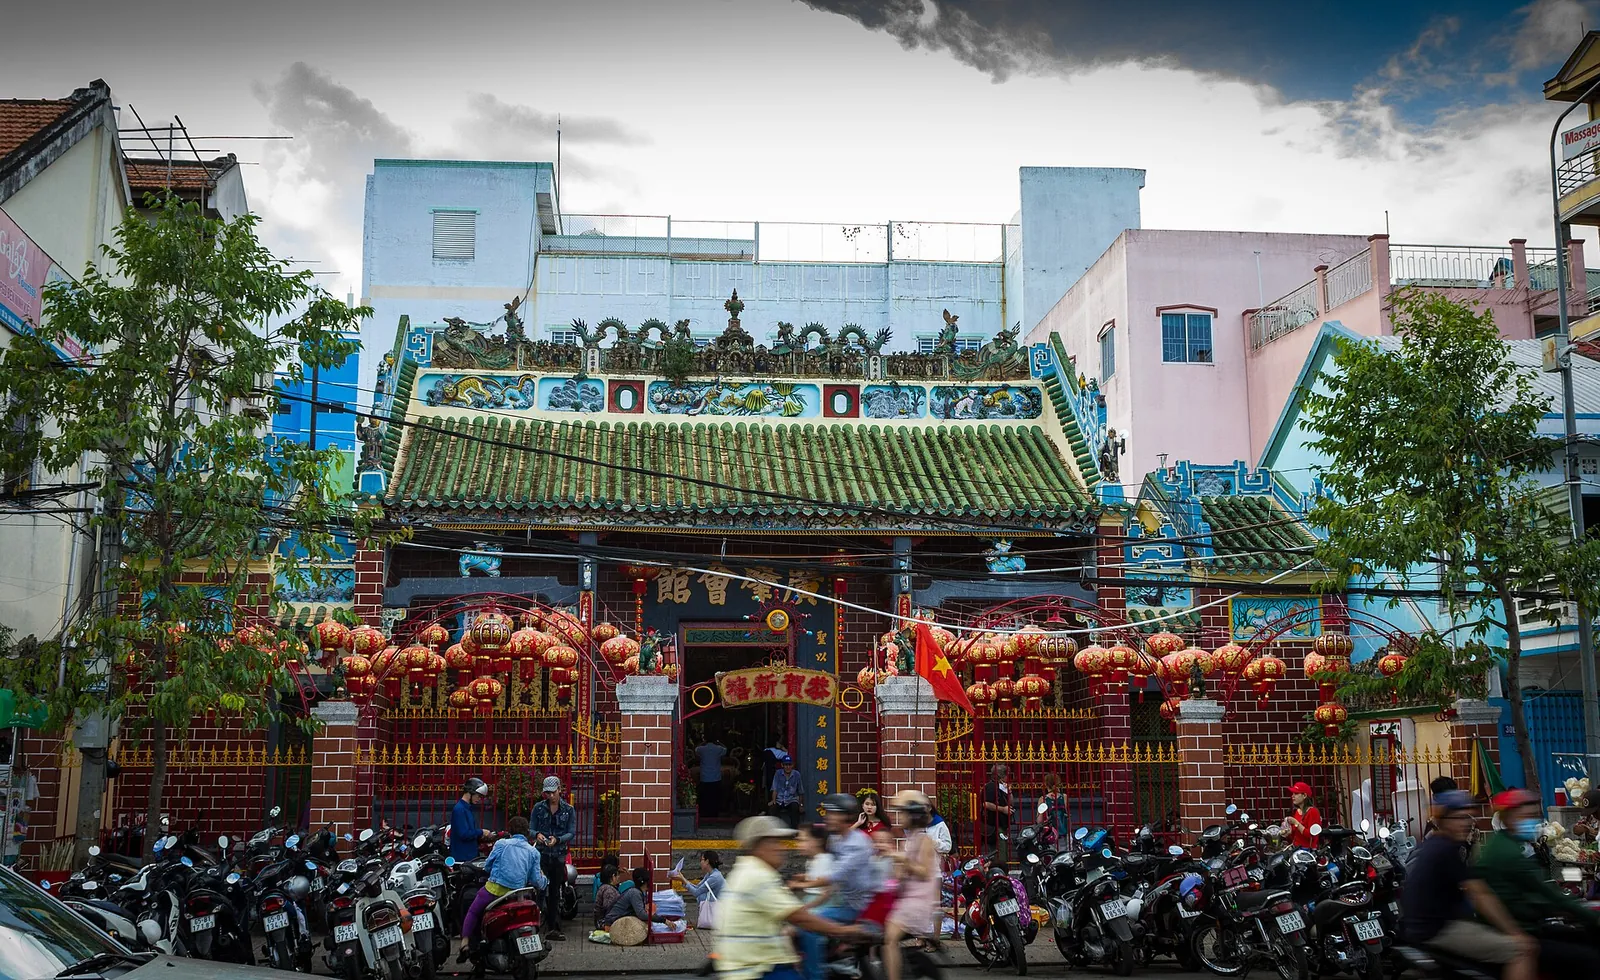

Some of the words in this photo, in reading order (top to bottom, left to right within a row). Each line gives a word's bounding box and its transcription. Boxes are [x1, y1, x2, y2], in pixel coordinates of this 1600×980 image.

[725, 673, 829, 702] 恭賀新禧
[376, 926, 396, 939] 65-F9
[1281, 920, 1303, 932] 333.97
[378, 934, 397, 947] 7847
